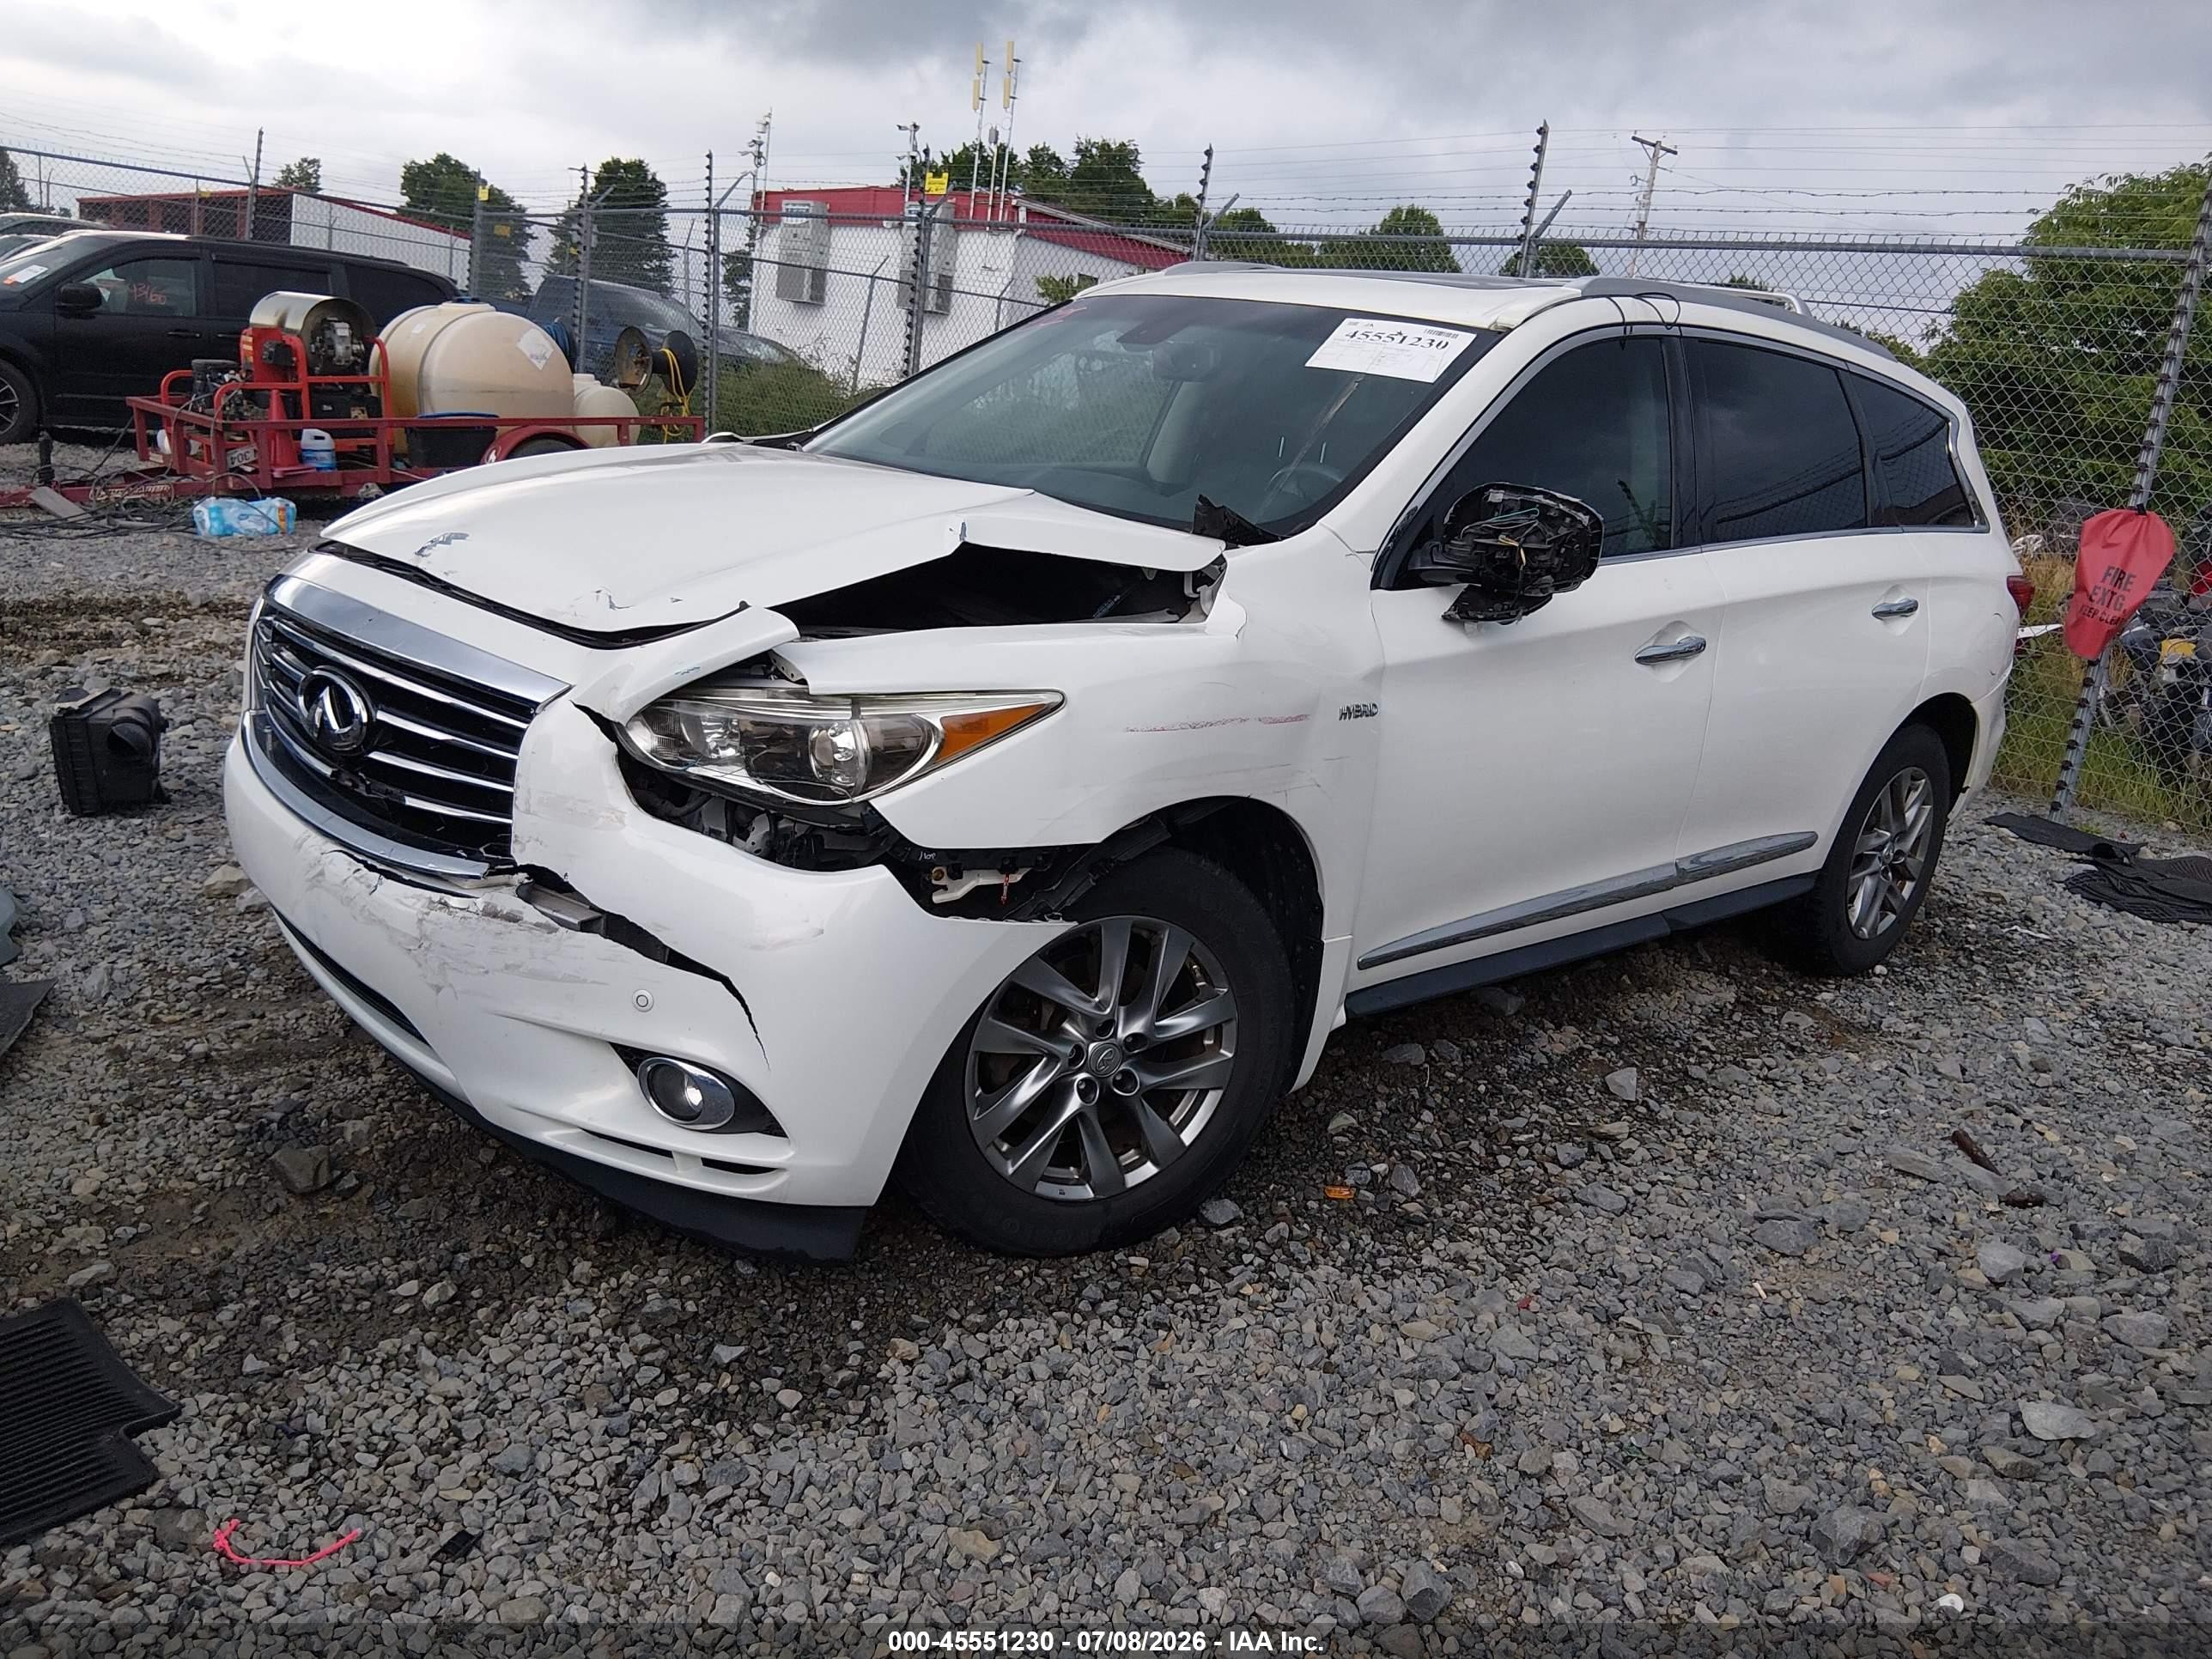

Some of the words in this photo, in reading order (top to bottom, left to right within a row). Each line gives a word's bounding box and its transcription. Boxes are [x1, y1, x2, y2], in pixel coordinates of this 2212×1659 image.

[1345, 330, 1449, 350] 45551230
[2100, 565, 2136, 592] FIRE
[1339, 703, 1378, 721] HYBRID
